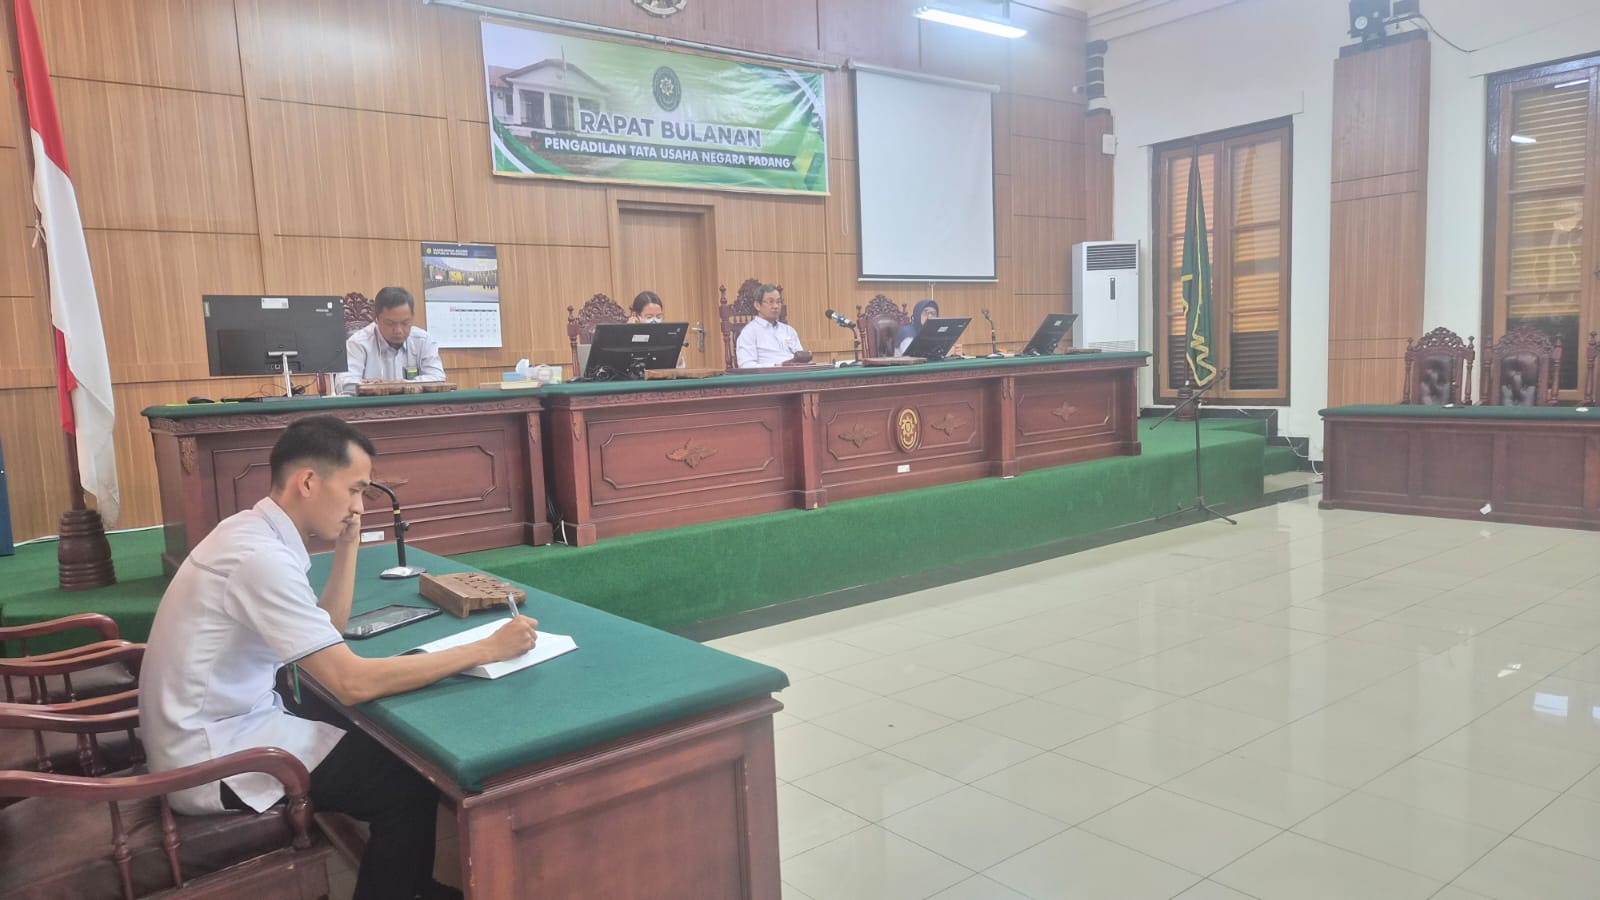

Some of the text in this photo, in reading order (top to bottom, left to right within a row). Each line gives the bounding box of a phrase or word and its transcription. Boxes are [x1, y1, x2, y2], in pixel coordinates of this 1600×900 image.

[579, 111, 762, 148] RAPAT BULANAN
[544, 136, 791, 169] PENGADILAN TATA USAHA NEGARA PADANG
